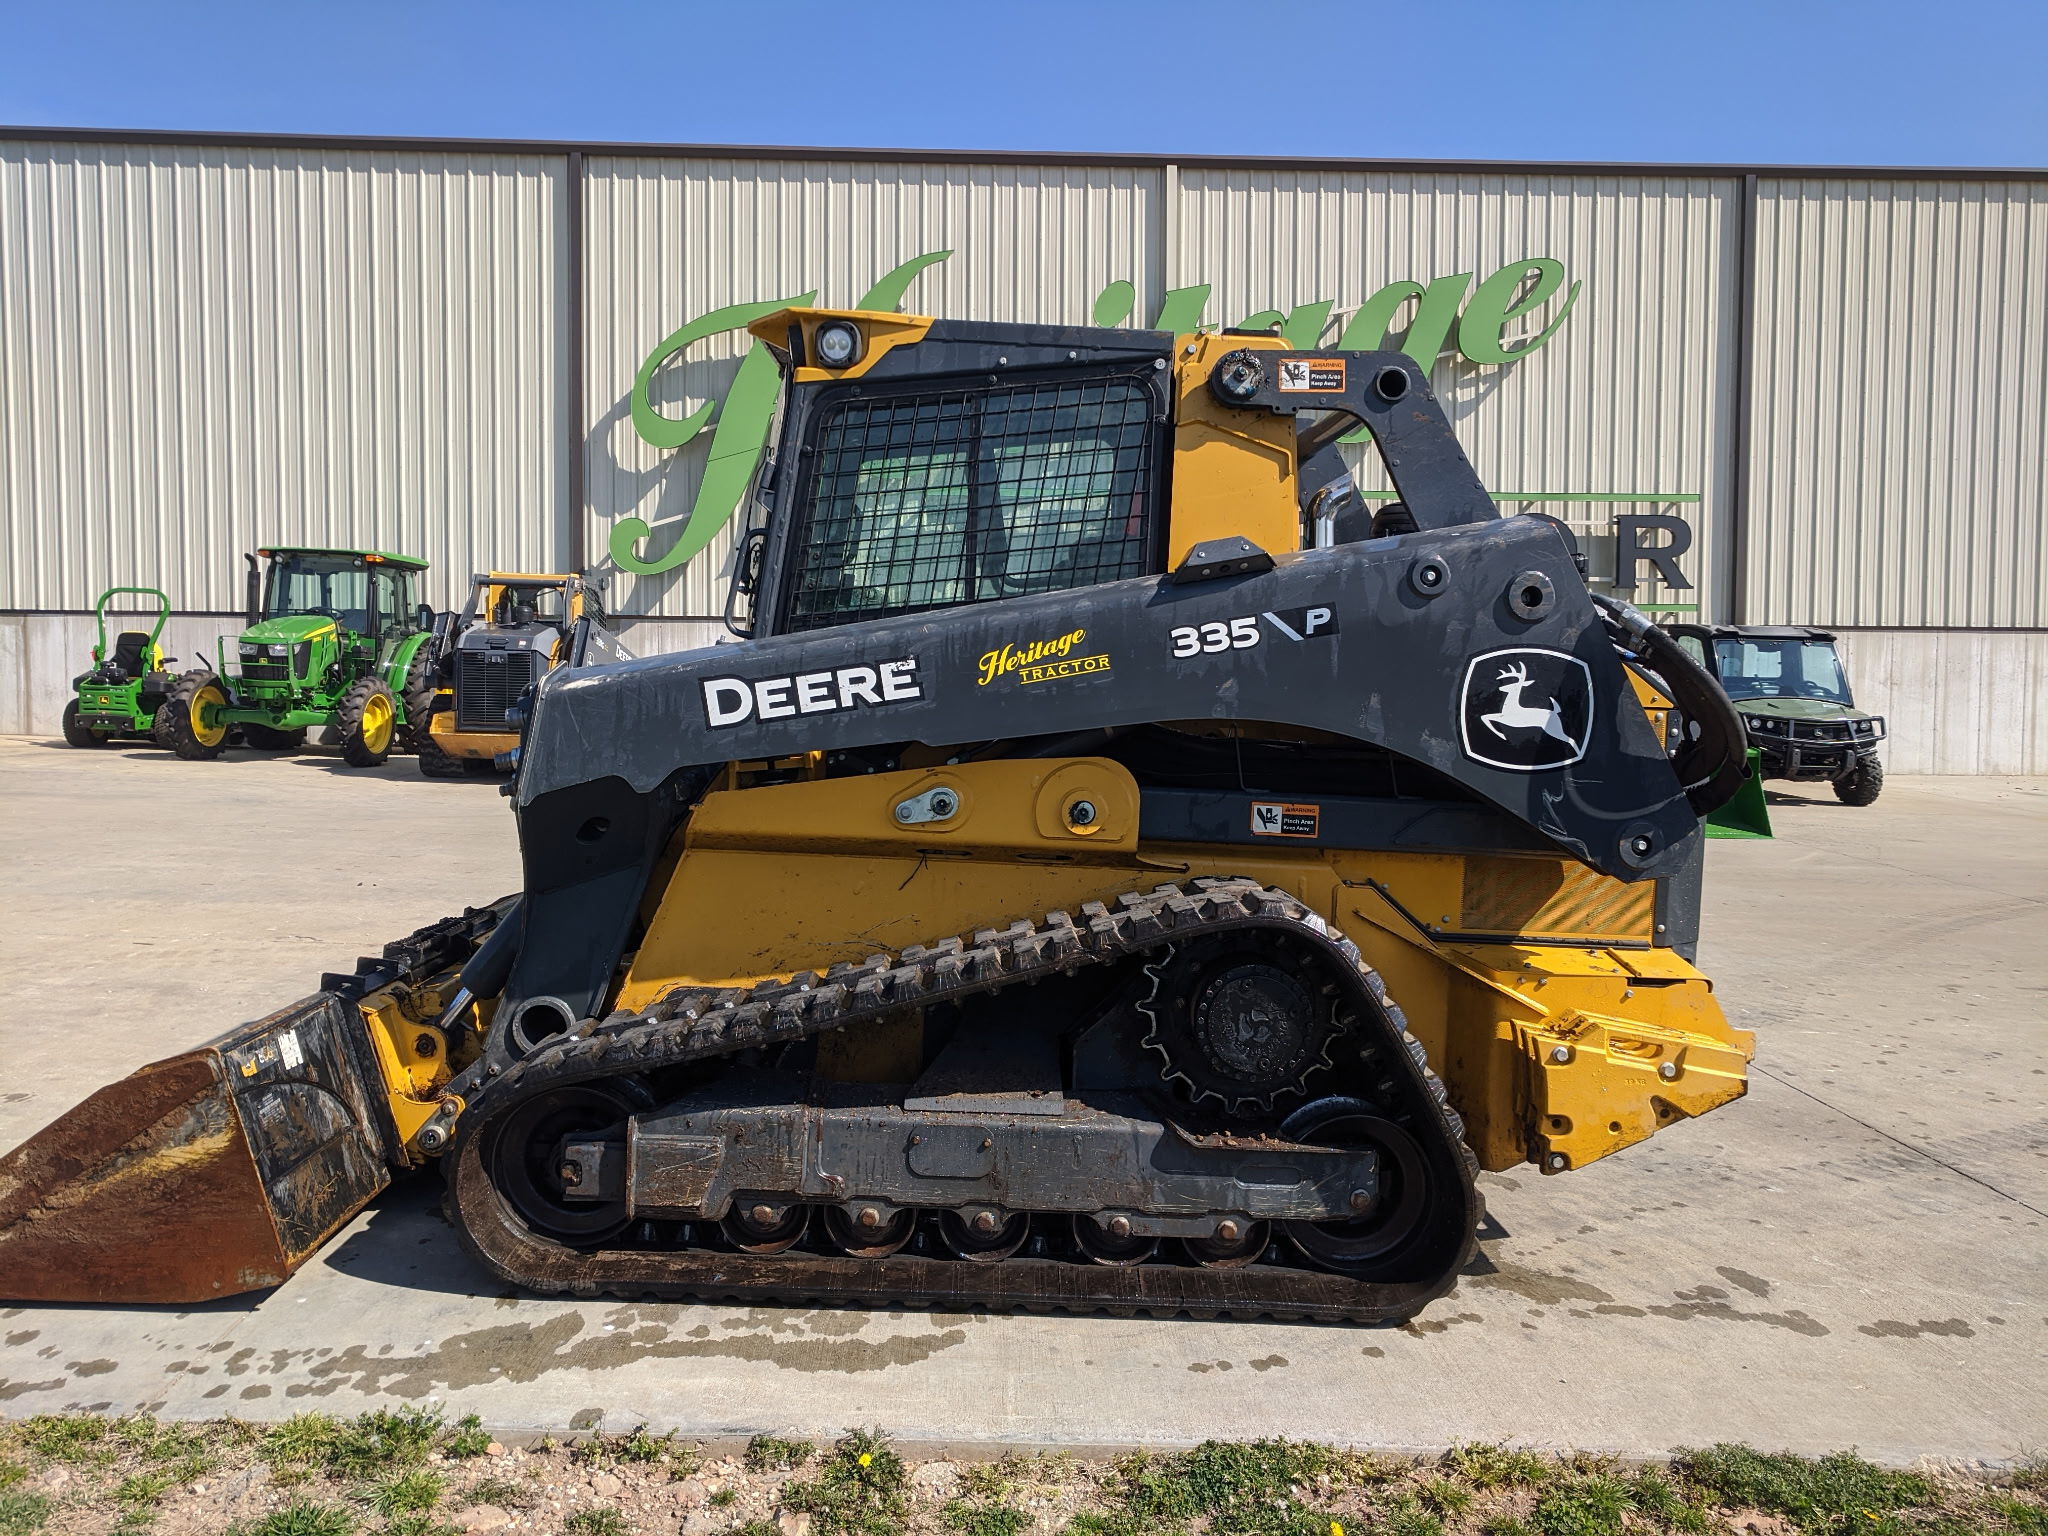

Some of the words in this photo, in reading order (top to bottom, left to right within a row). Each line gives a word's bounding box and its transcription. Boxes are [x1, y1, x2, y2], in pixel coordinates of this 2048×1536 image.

[978, 629, 1086, 686] Heritage
[1170, 616, 1260, 658] 335
[704, 659, 921, 727] DEERE
[1020, 657, 1110, 682] TRACTOR
